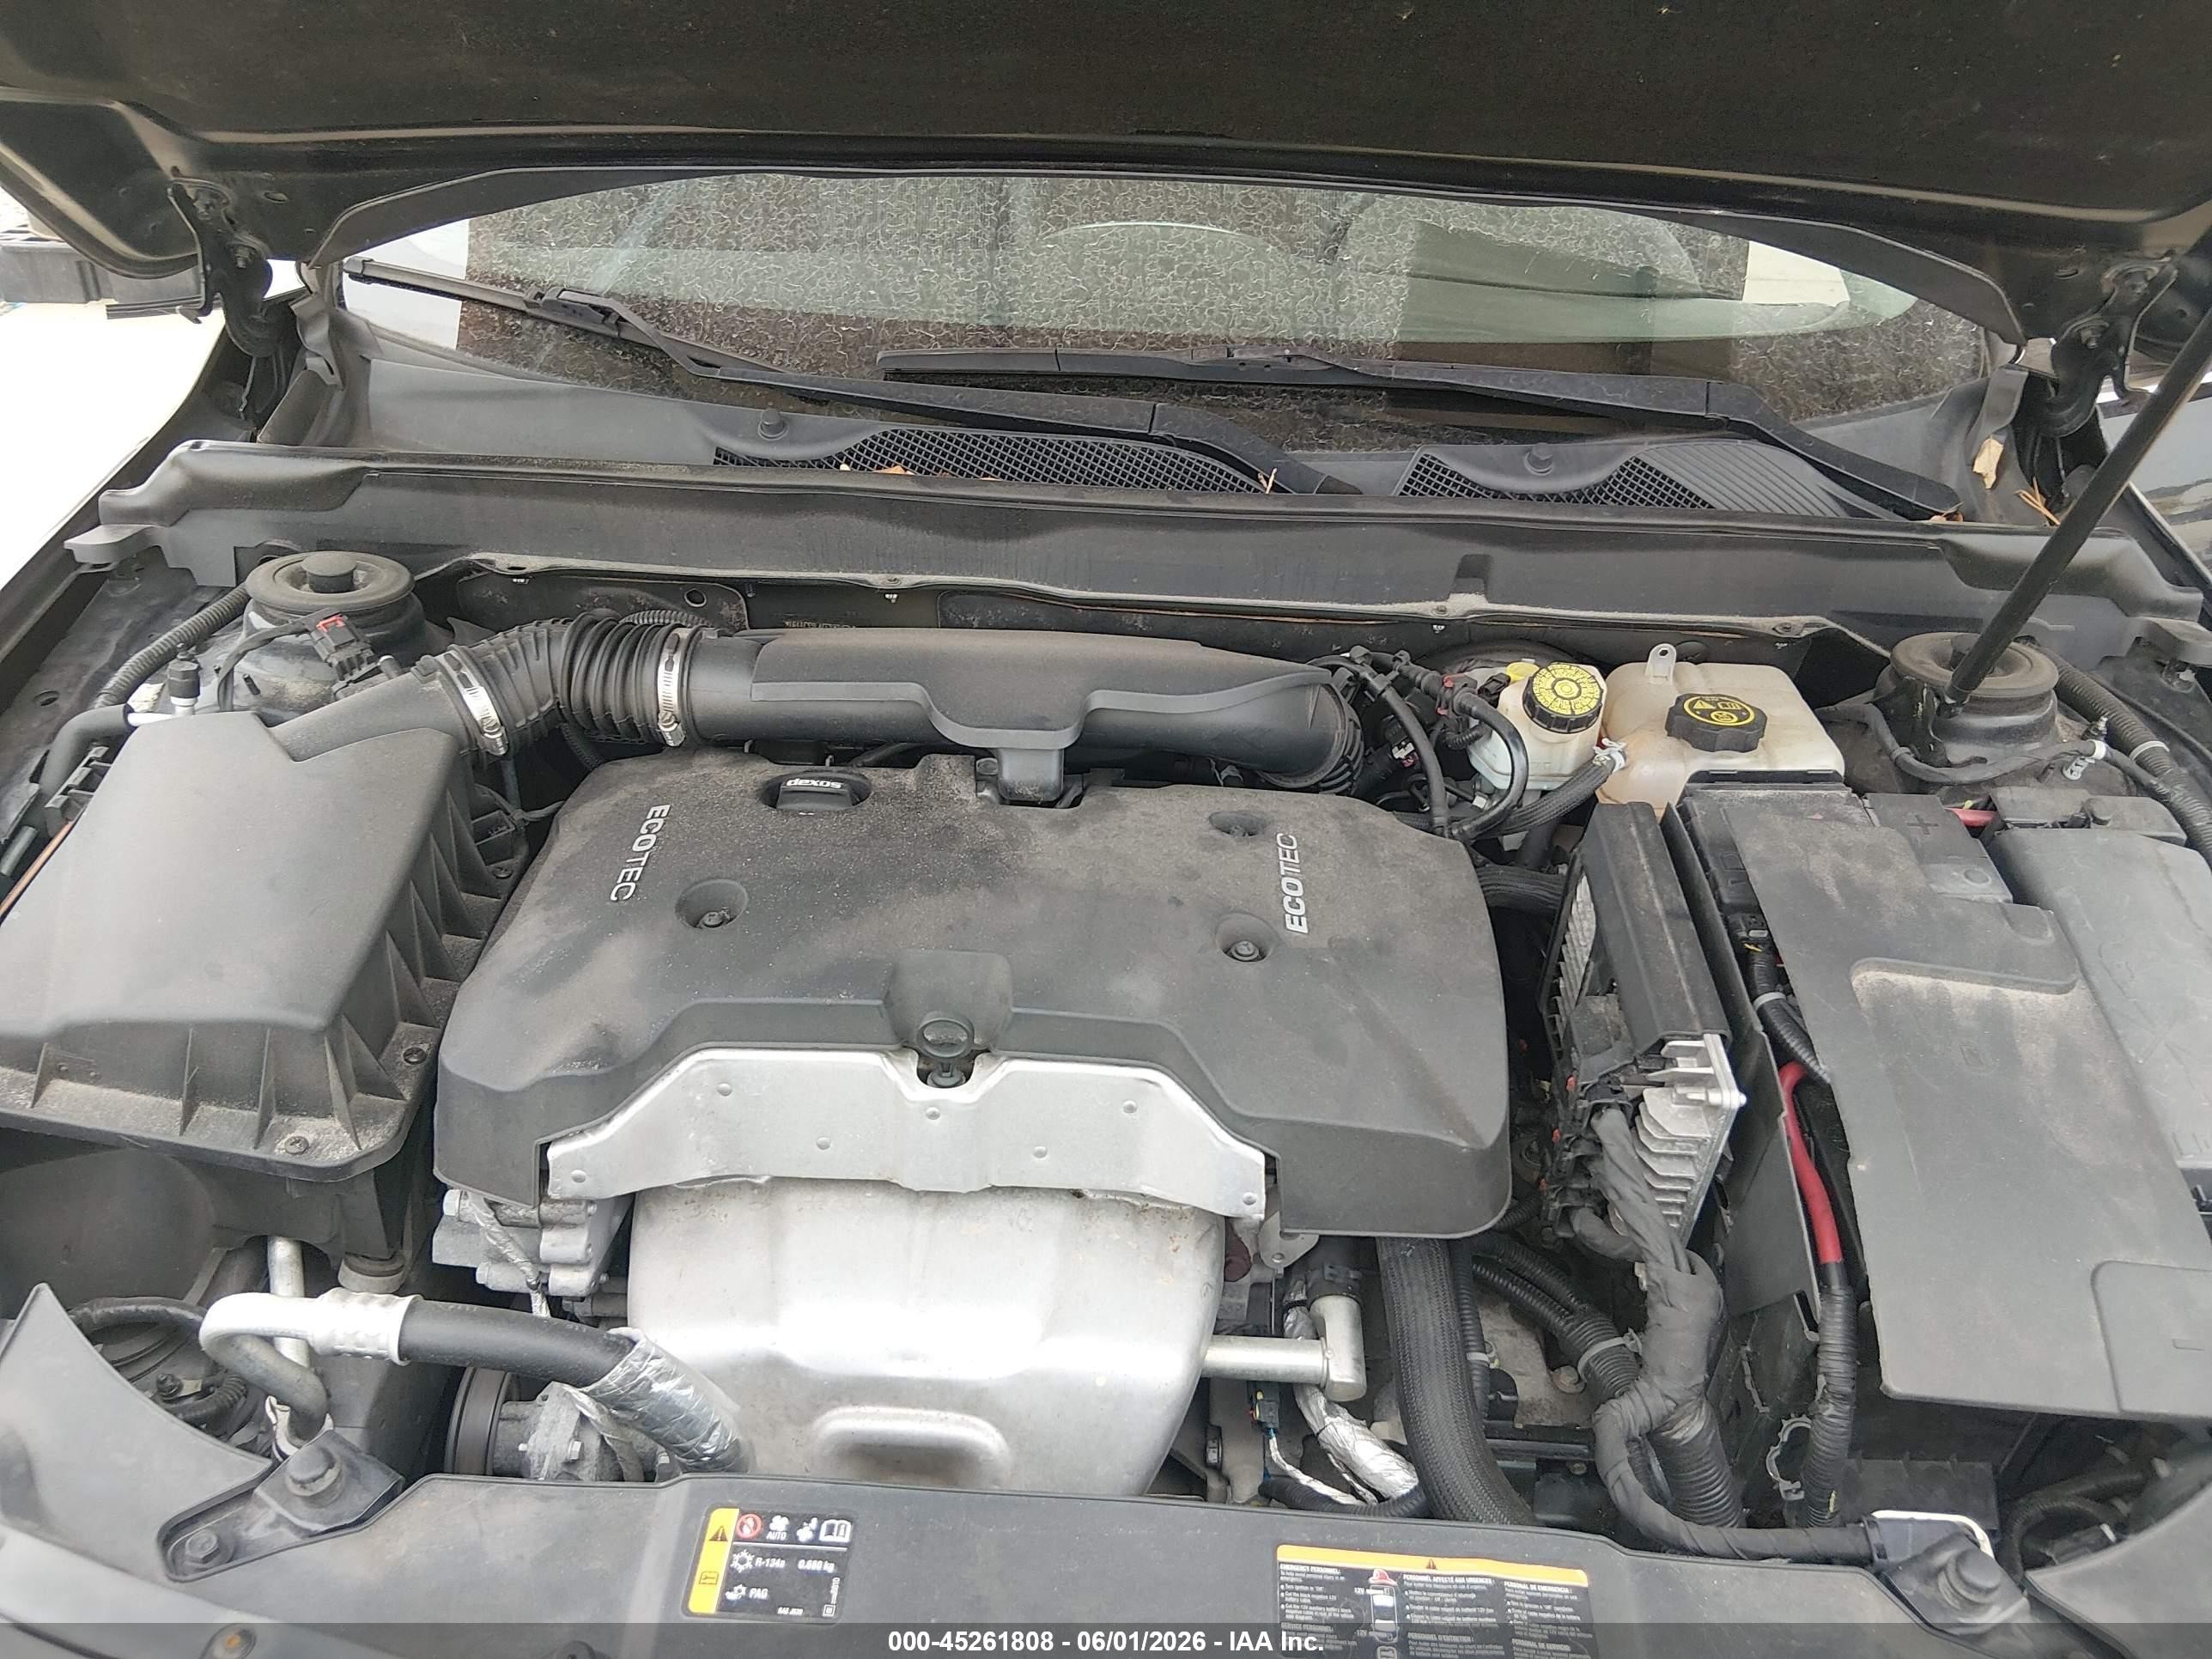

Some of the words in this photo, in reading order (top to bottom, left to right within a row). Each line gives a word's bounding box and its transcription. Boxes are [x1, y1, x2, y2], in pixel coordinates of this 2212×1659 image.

[787, 778, 844, 789] dexos
[610, 804, 672, 902] ECOTEC
[1276, 833, 1309, 934] ECOTEC
[766, 1531, 787, 1540] AUTO
[755, 1557, 786, 1568] R-134a
[823, 1560, 836, 1573] kg
[749, 1588, 769, 1600] PAG
